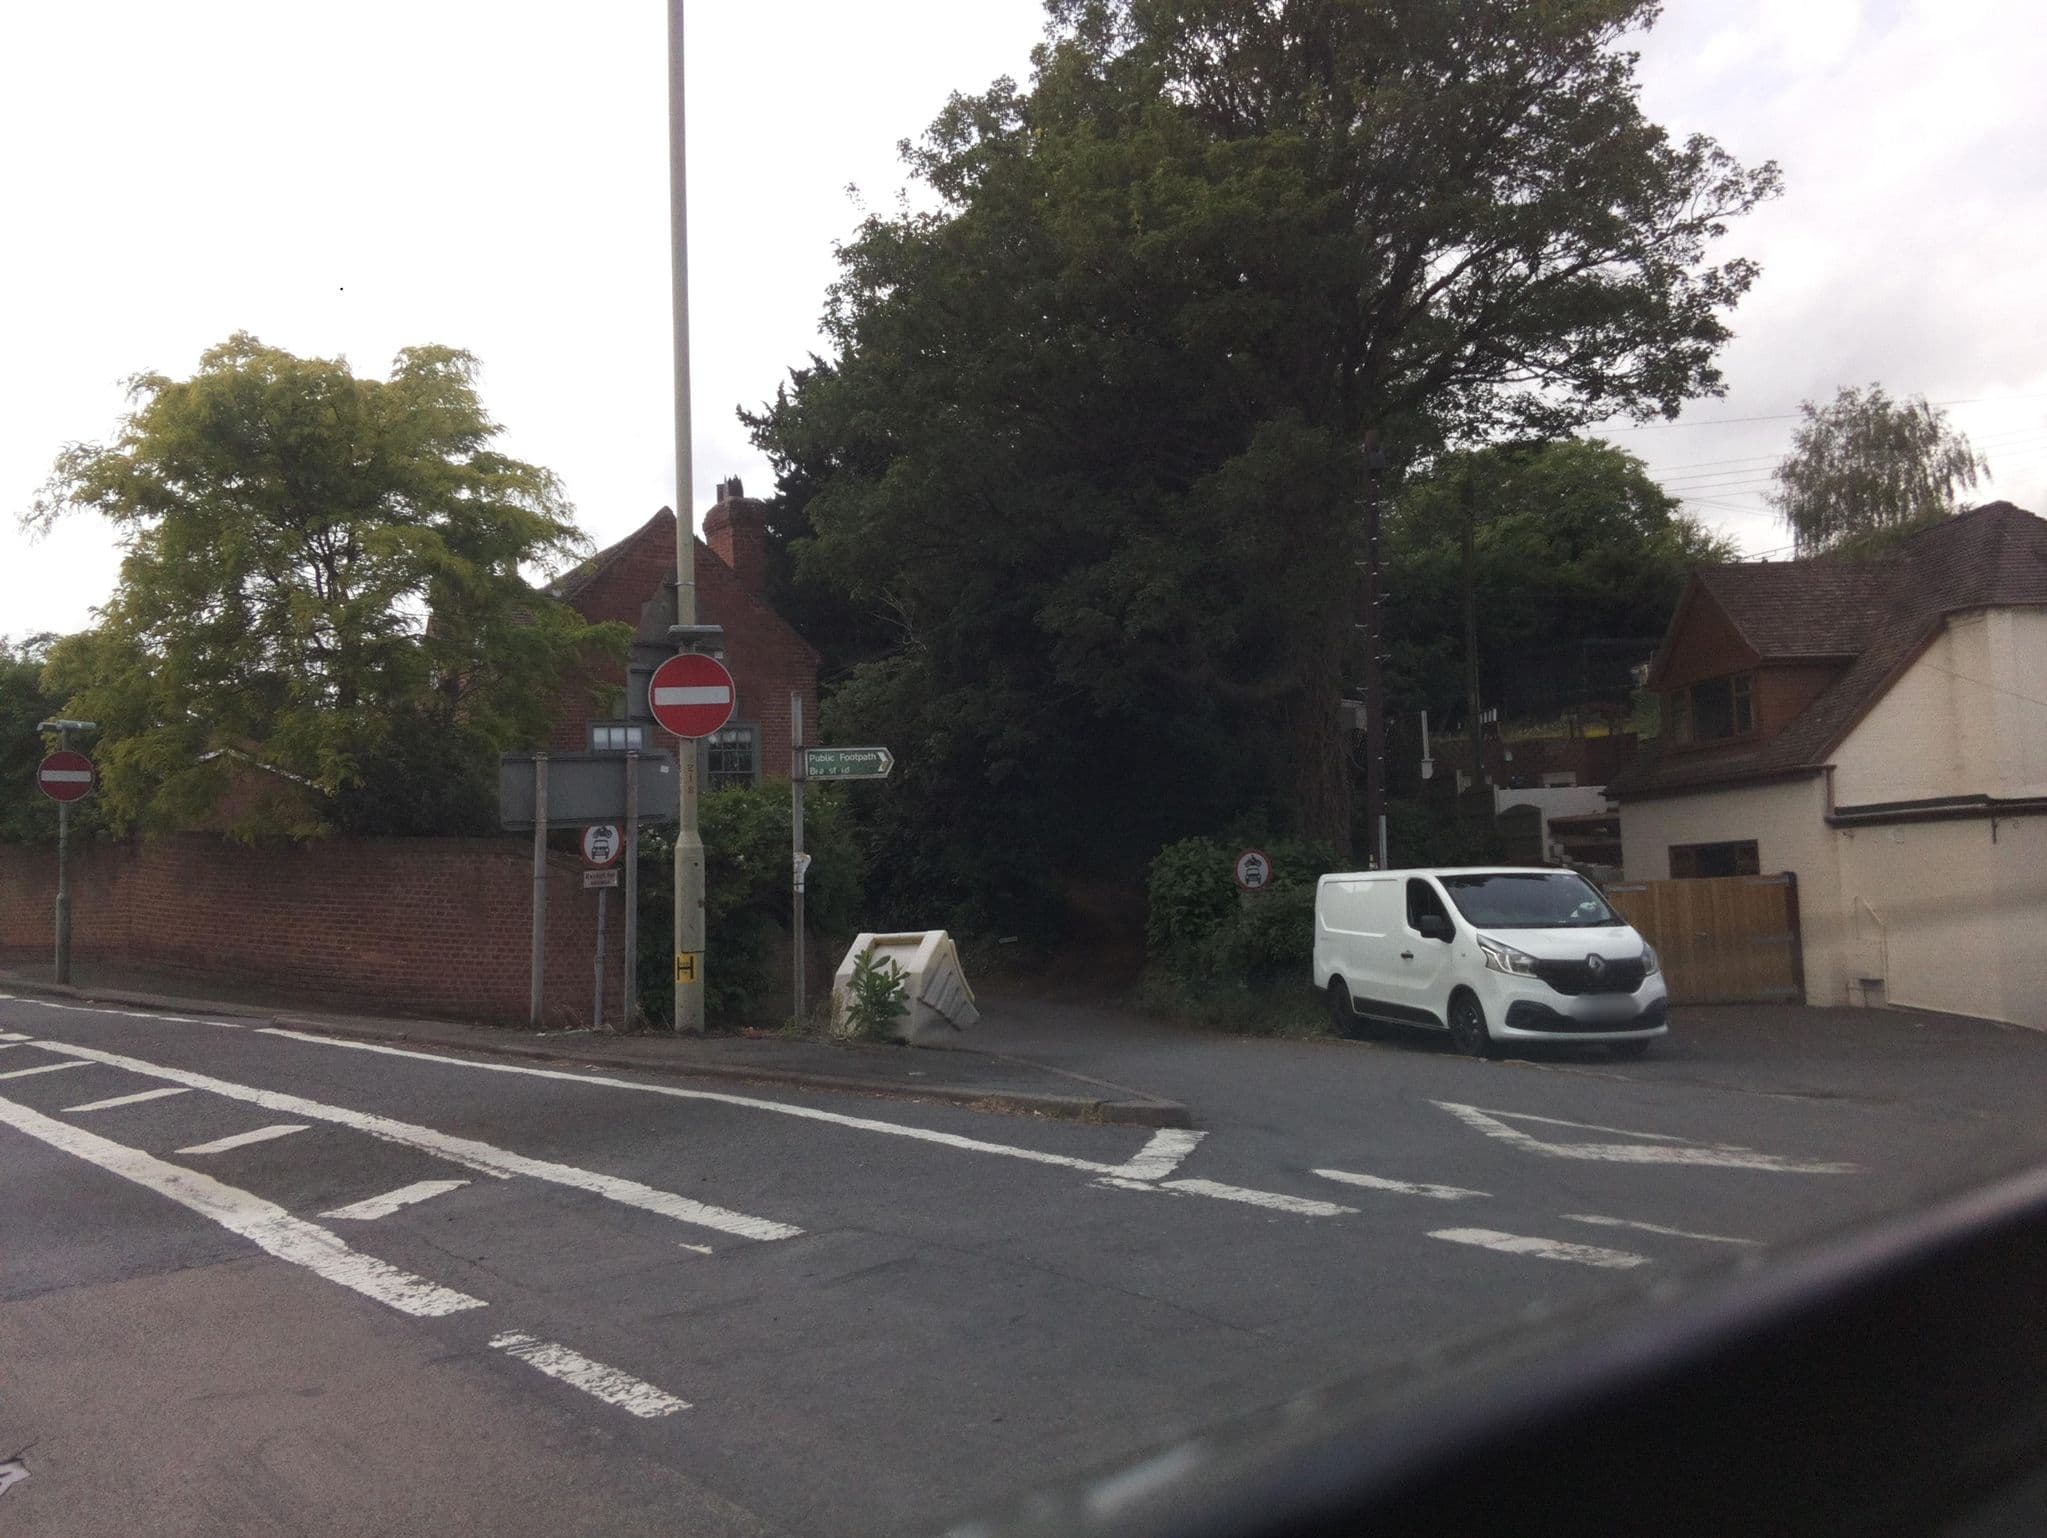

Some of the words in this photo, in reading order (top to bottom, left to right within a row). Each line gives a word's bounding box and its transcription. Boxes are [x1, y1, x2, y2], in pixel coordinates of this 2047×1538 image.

[809, 754, 835, 762] Public
[839, 752, 876, 762] Footpath
[677, 956, 694, 981] H
